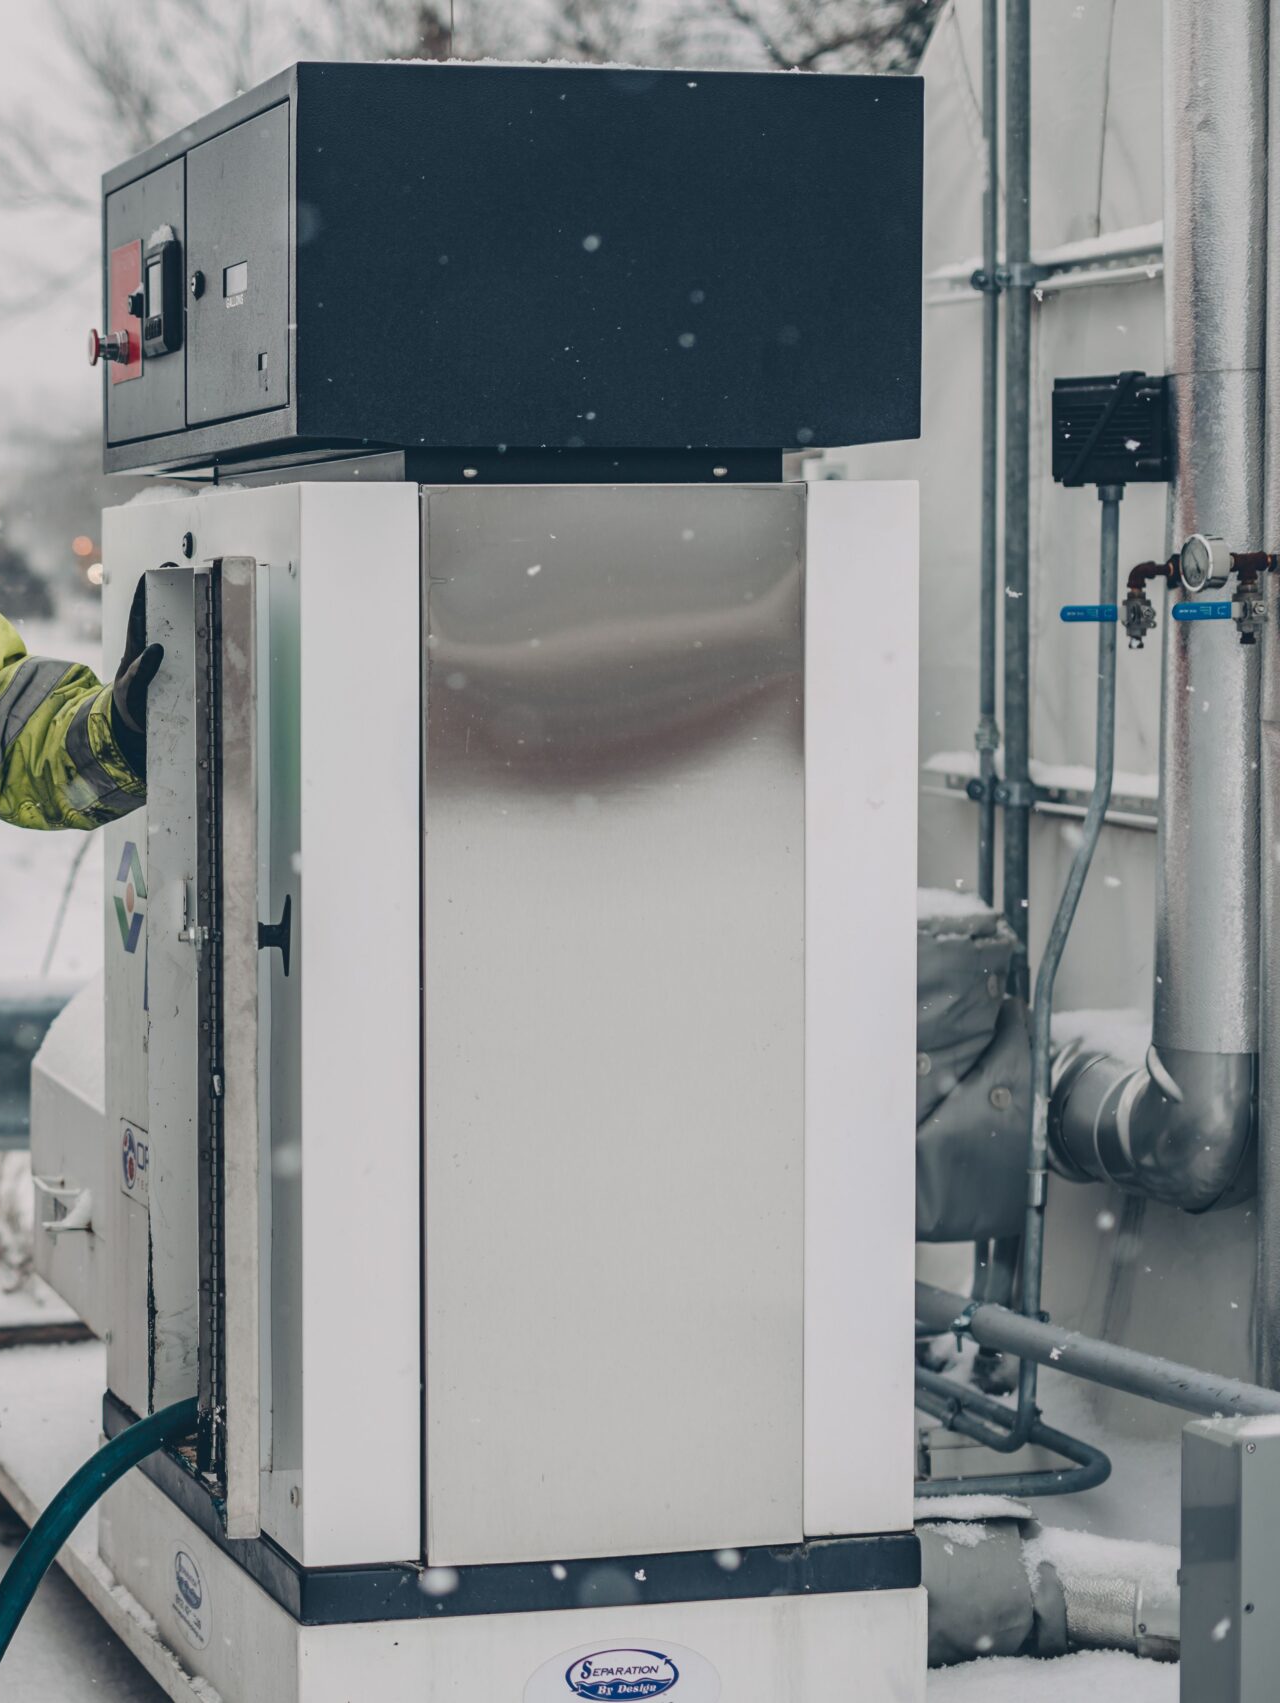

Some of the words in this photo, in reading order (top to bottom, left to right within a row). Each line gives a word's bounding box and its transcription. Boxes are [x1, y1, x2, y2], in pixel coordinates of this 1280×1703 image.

[581, 1661, 659, 1679] SEPARATION
[597, 1685, 613, 1696] By
[618, 1683, 657, 1694] Design
